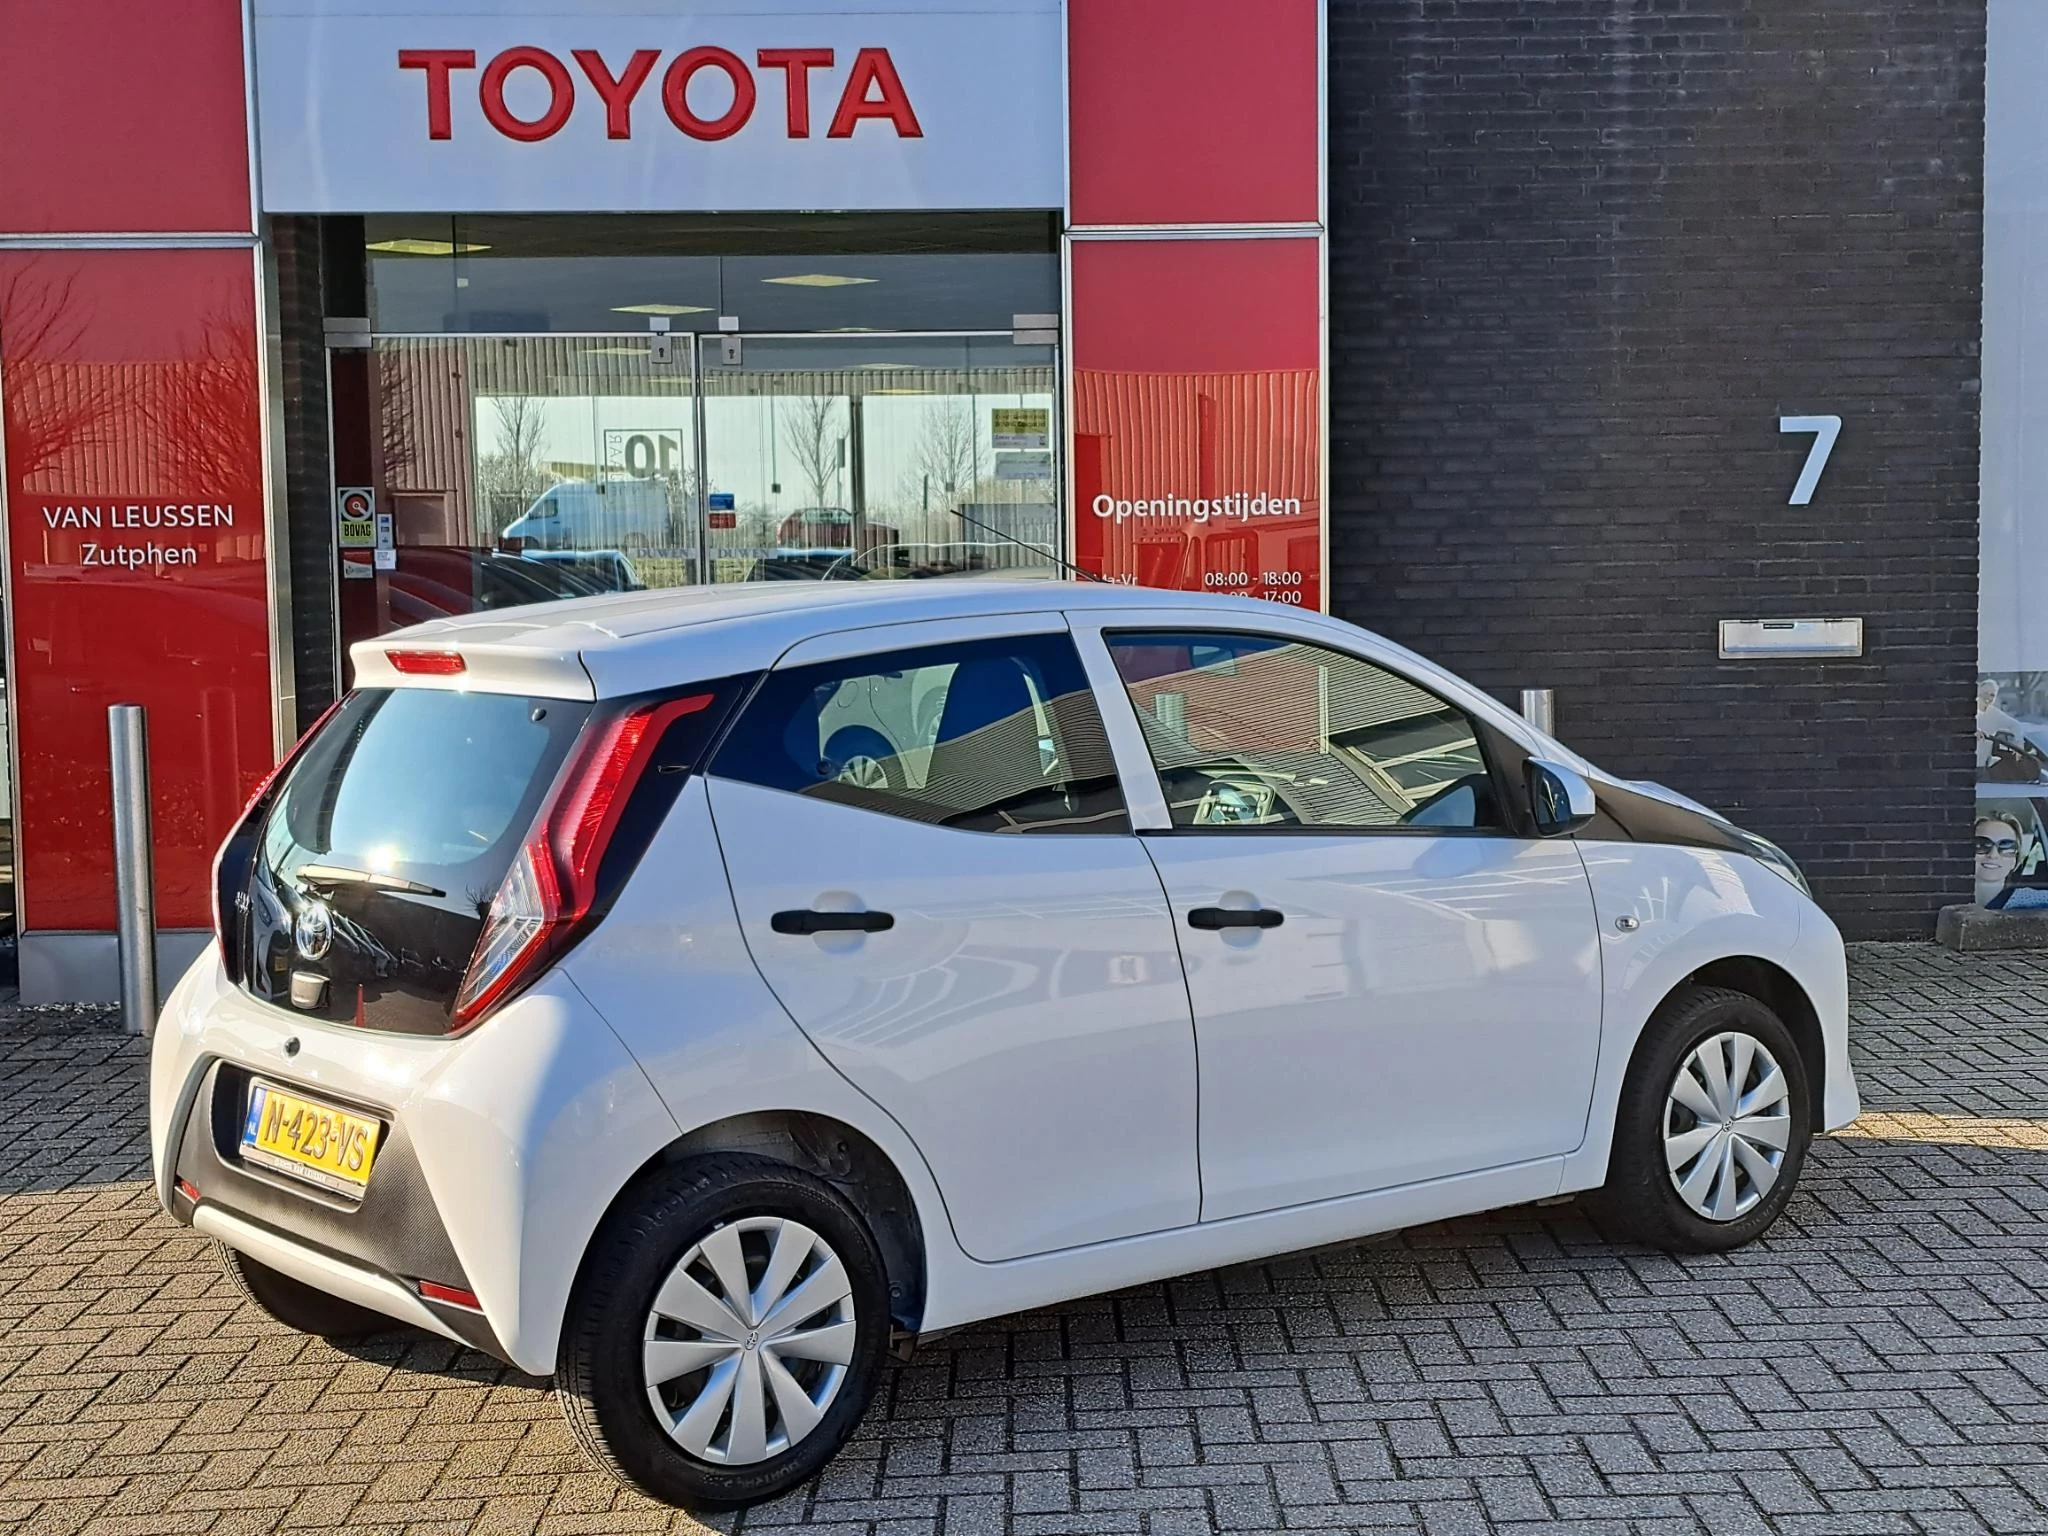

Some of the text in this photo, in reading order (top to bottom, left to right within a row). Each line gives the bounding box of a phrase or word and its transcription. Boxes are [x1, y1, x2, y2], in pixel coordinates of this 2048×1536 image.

[398, 46, 924, 142] TOYOTA
[1780, 415, 1842, 505] 7
[43, 504, 233, 529] VAN LEUSSEN
[1092, 492, 1301, 523] Openingstijden
[344, 524, 371, 537] BOVAG
[82, 542, 197, 571] Zutphen
[1204, 572, 1248, 586] 08:00
[1263, 571, 1302, 585] 18:00
[1263, 590, 1302, 604] 17:00
[247, 1121, 258, 1137] NL
[264, 1100, 368, 1172] N-423-VS
